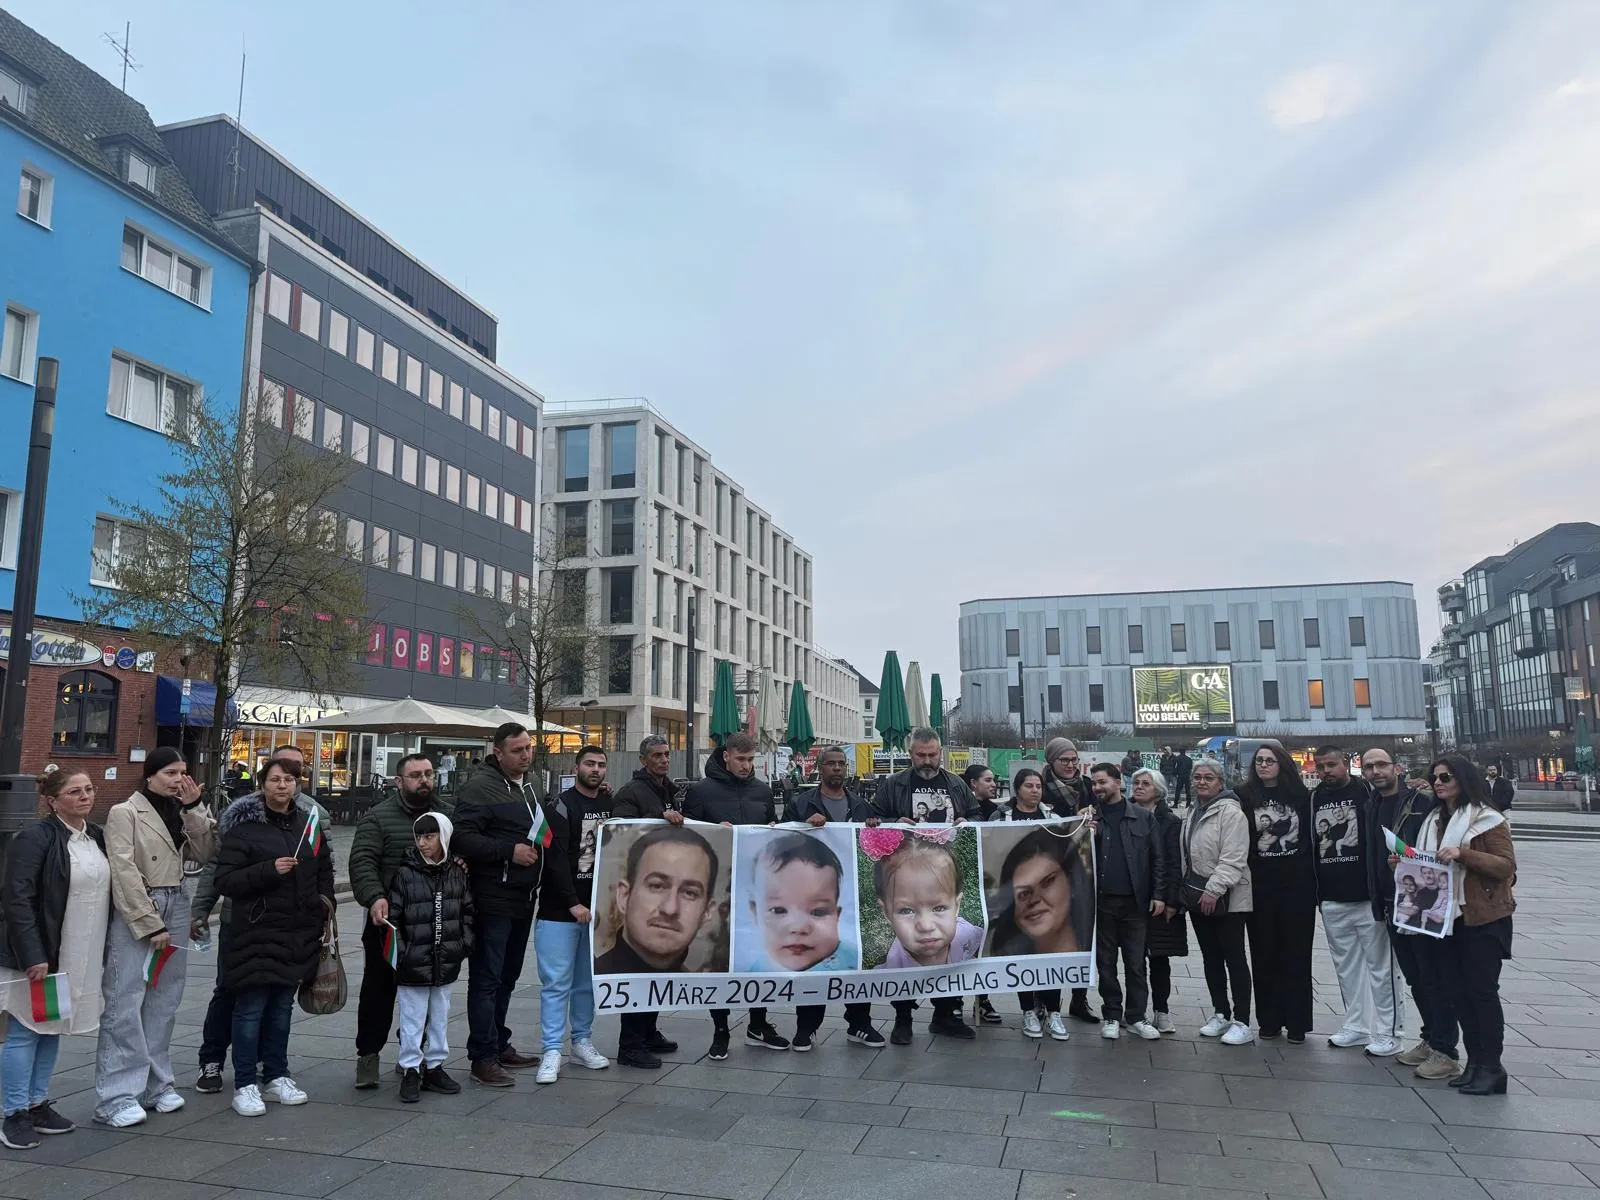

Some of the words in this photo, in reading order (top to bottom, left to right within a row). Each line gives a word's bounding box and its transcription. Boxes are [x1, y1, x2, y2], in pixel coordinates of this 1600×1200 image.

[373, 633, 451, 666] JOBS
[1191, 672, 1225, 690] C&A
[1139, 703, 1160, 712] LIVE
[1161, 703, 1189, 712] WHAT
[1140, 712, 1160, 721] YOU
[1161, 712, 1200, 721] BELIEVE
[1319, 799, 1354, 810] ADALET
[598, 981, 638, 1010] 25.
[725, 979, 795, 1004] 2024
[1006, 962, 1091, 988] SOLINGE
